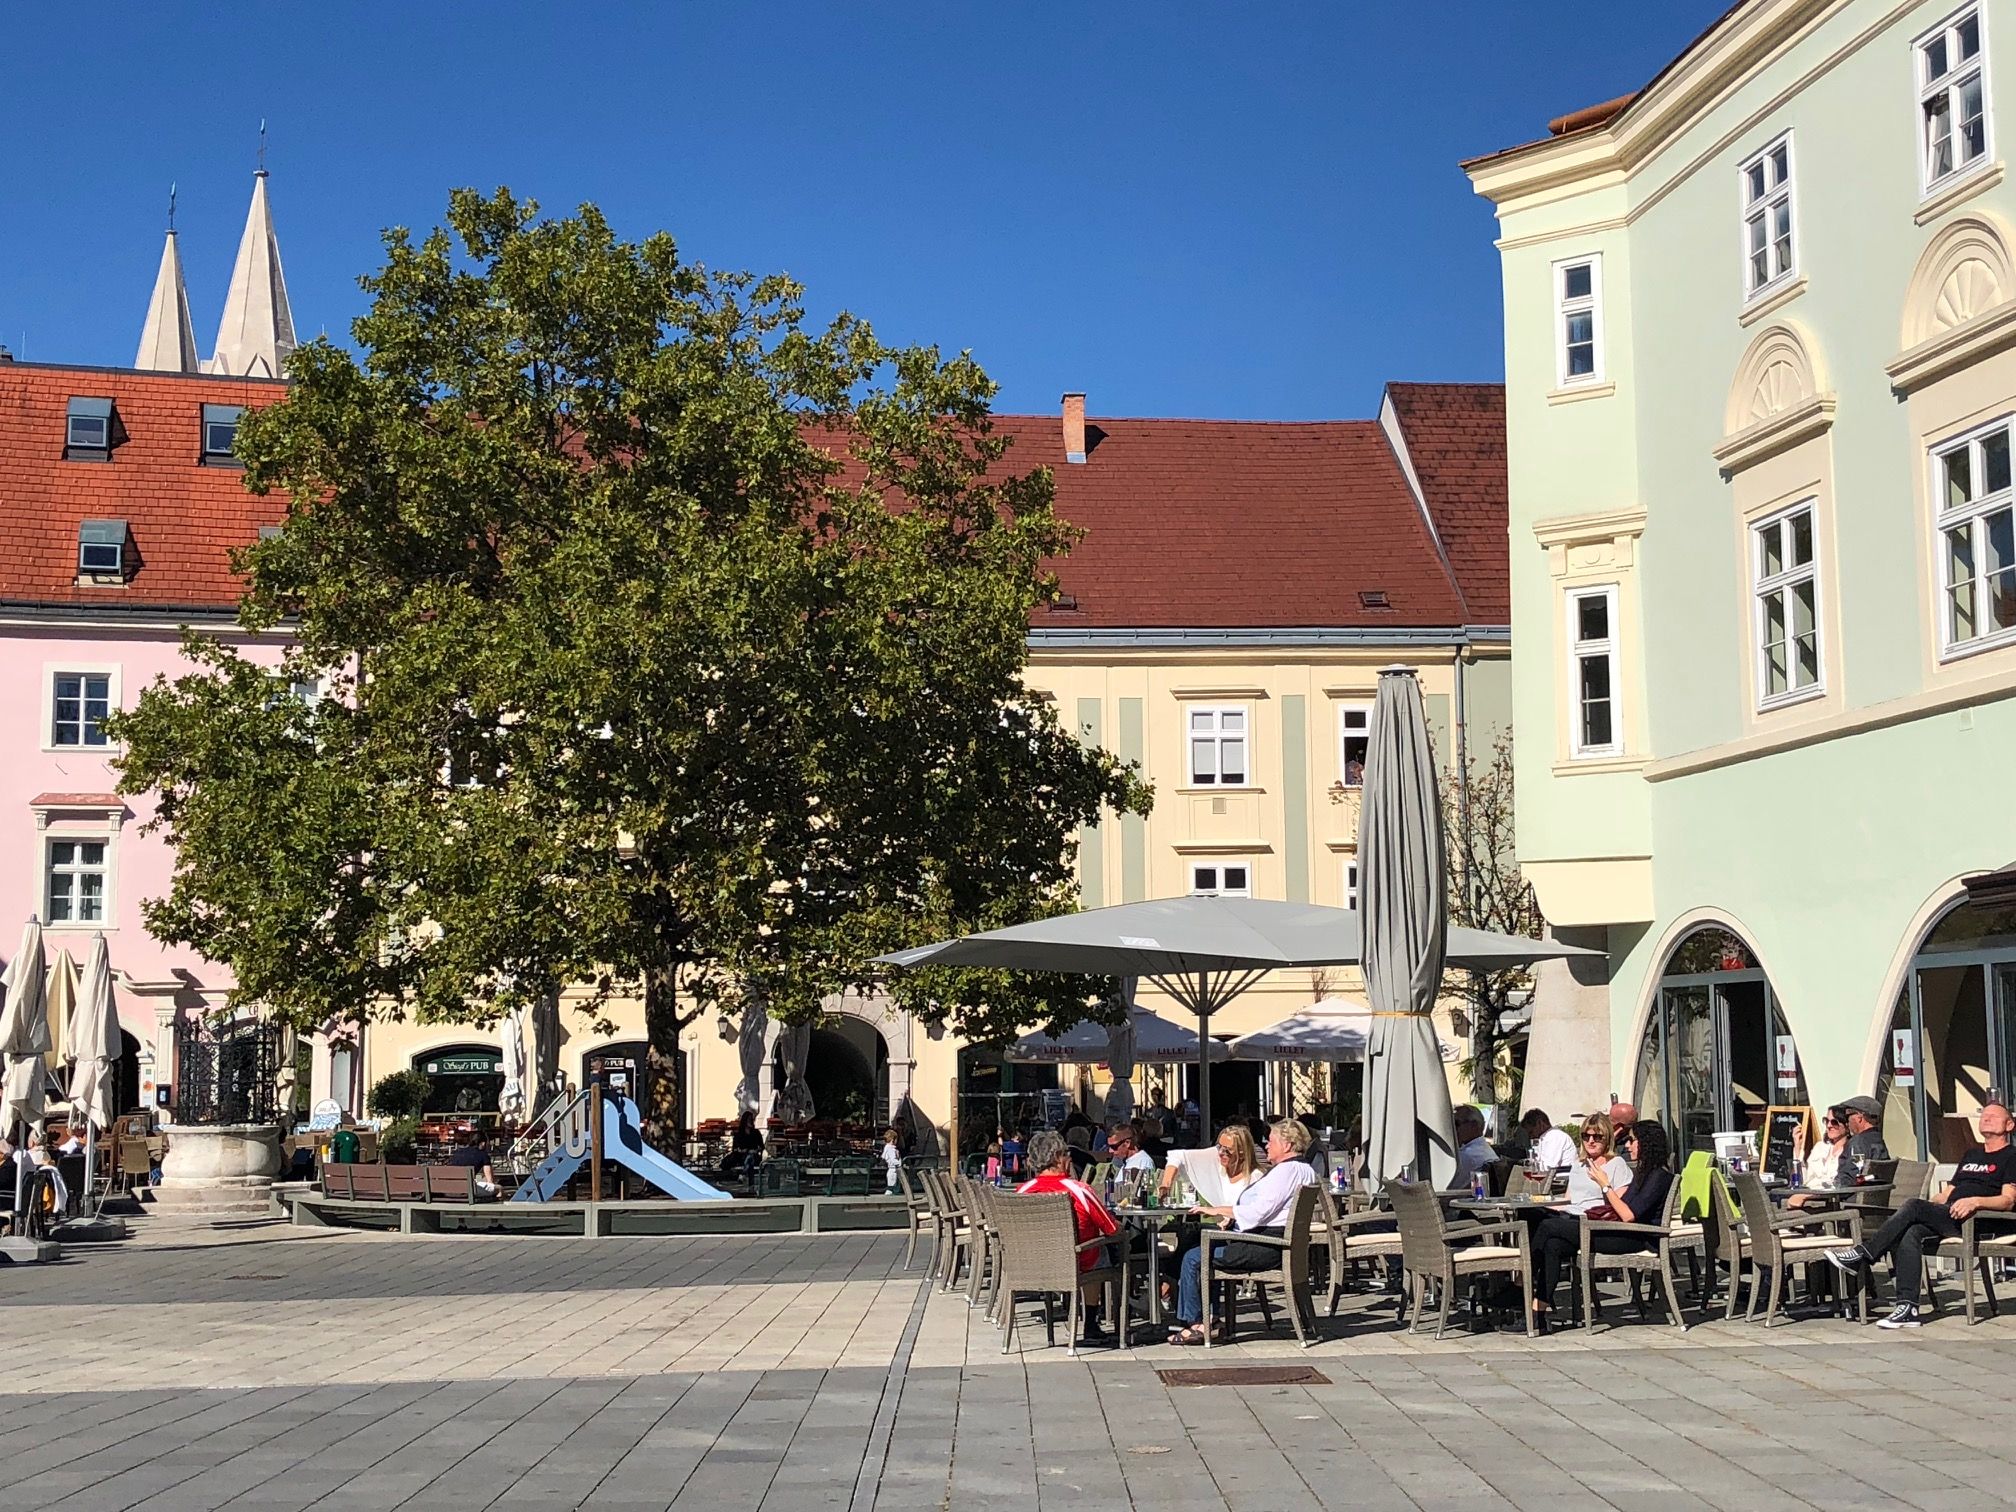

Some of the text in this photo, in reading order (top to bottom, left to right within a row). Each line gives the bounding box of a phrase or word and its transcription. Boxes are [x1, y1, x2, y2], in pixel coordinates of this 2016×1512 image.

[1157, 1047, 1188, 1055] LILLET
[1273, 1045, 1305, 1054] LILLET
[470, 1061, 489, 1070] PUB
